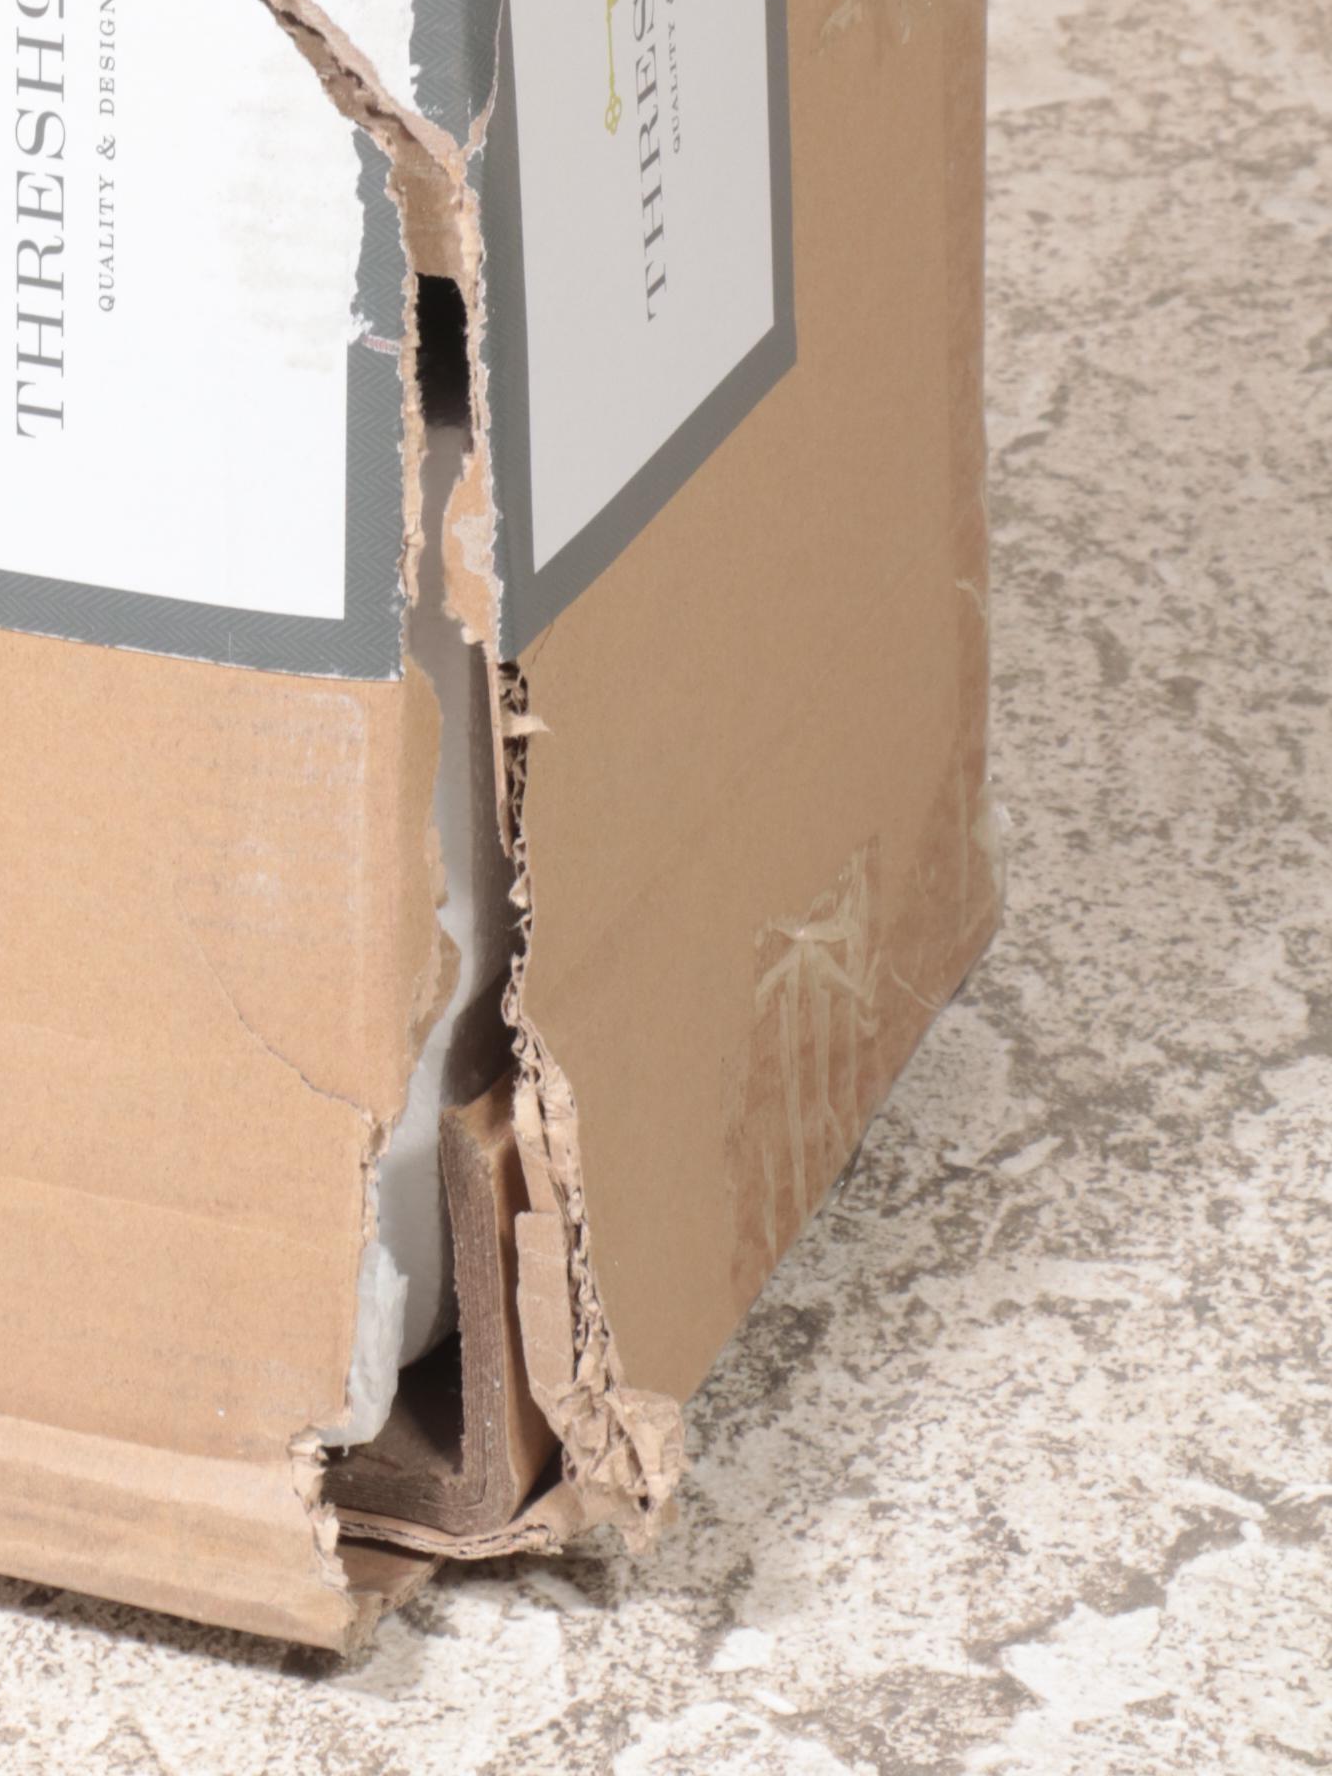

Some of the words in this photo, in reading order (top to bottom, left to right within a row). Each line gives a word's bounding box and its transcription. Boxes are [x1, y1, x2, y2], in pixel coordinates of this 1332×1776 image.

[96, 135, 116, 161] &
[668, 22, 681, 154] QUALITY
[98, 174, 115, 312] QUALITY
